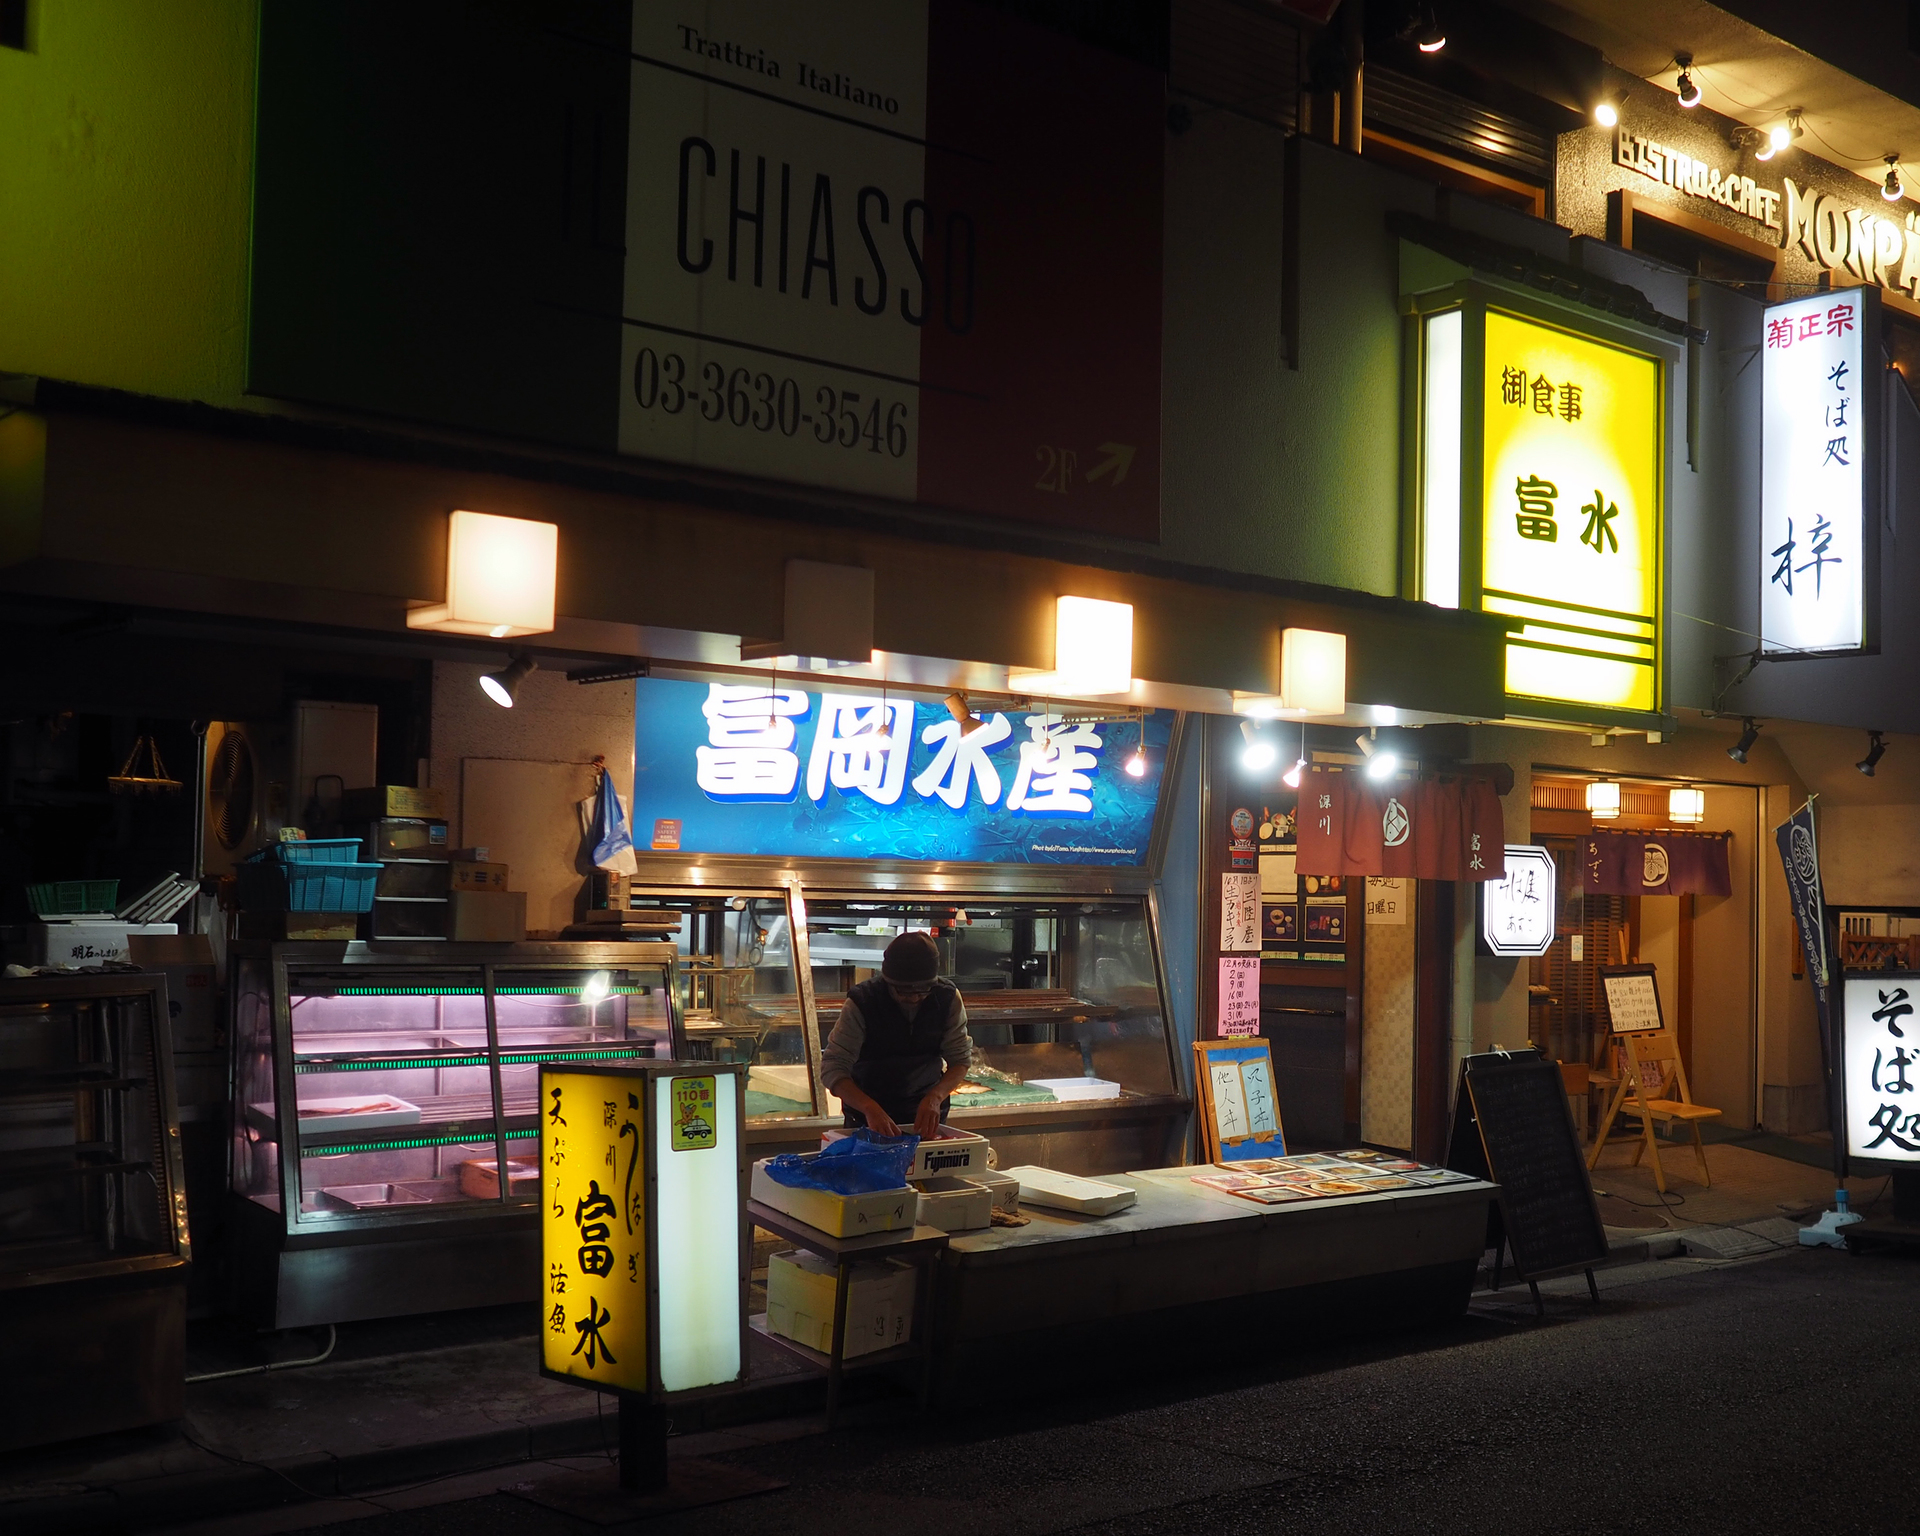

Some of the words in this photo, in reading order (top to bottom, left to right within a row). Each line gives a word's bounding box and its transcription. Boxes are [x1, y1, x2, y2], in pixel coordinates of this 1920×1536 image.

[678, 24, 781, 79] Trattria
[797, 62, 899, 116] Italiano
[677, 136, 976, 335] CHIASSO
[1767, 304, 1854, 349] 菊正宗
[634, 347, 908, 458] 03-3630-3546
[1501, 364, 1582, 422] 御食事
[1823, 360, 1850, 467] そば処
[1035, 444, 1077, 494] 2F
[1515, 474, 1619, 554] 富水
[1771, 513, 1842, 602] 梓
[696, 682, 1102, 818] 富岡水産
[1367, 899, 1396, 914] 日曜日
[677, 1089, 710, 1101] 110番
[682, 1080, 705, 1089] こども
[1862, 988, 1920, 1151] そば処
[924, 1151, 970, 1176] Fujimura
[548, 1263, 569, 1334] 活魚
